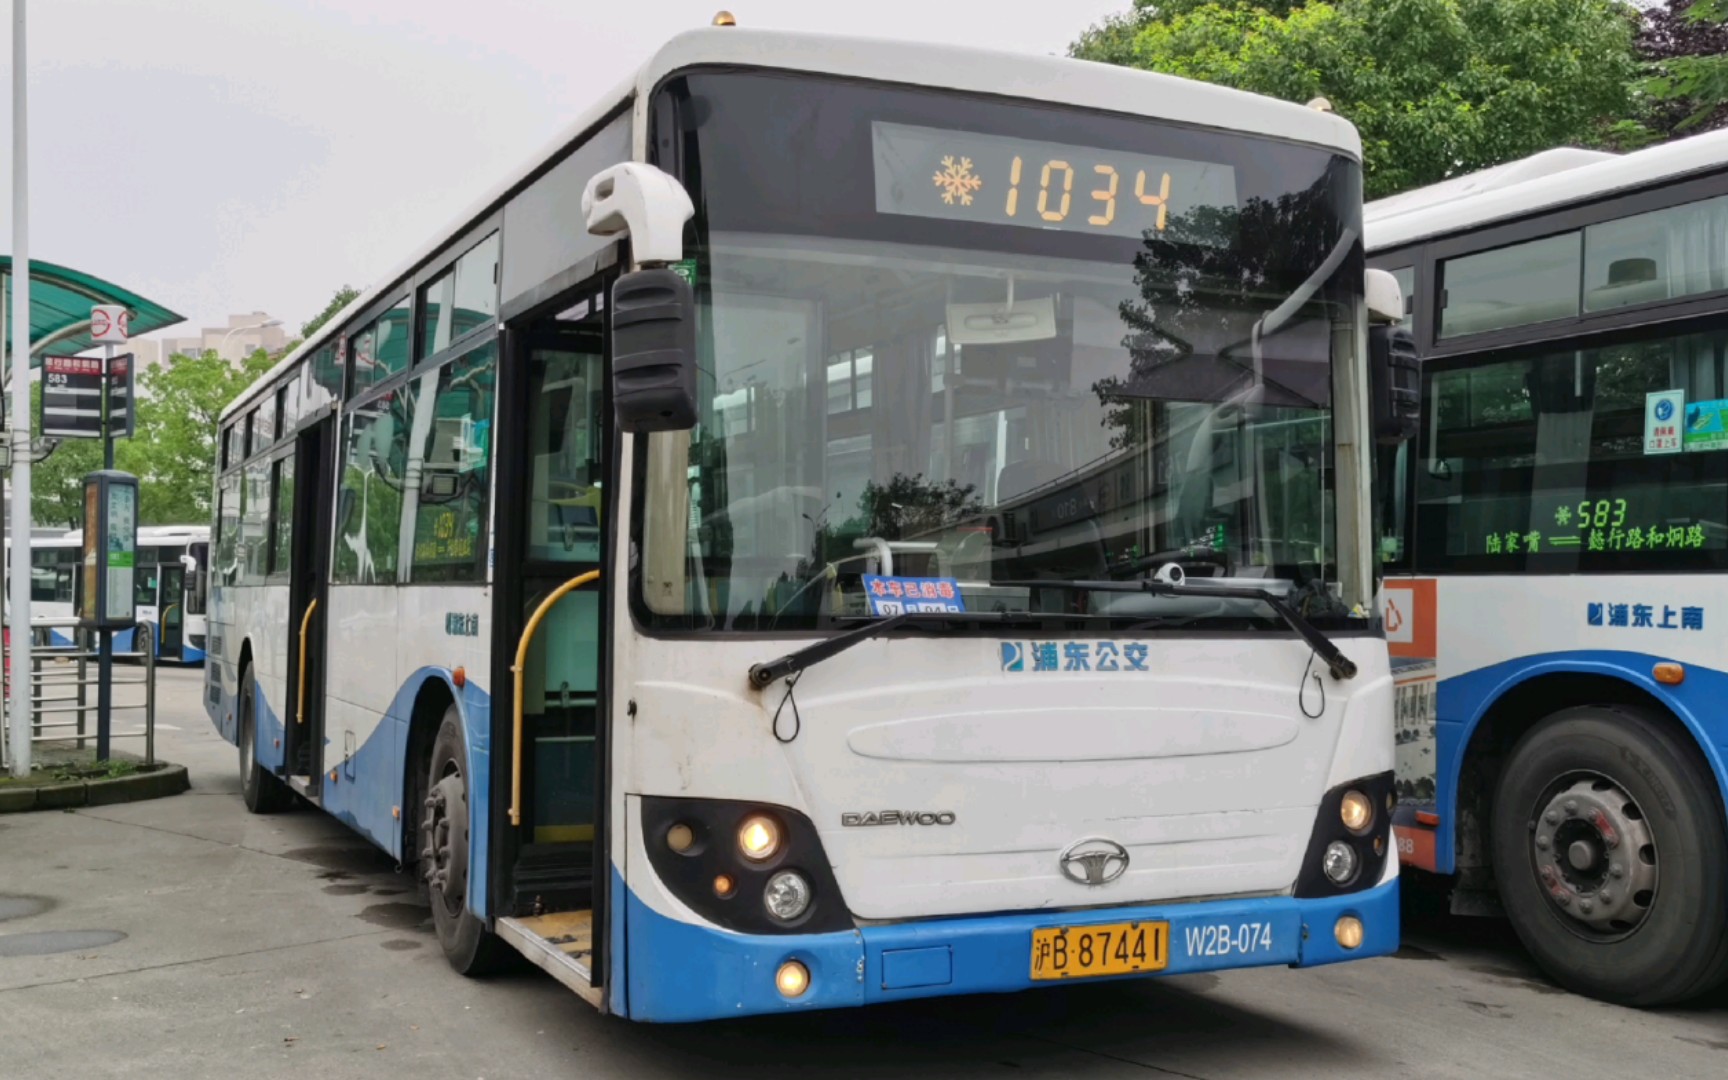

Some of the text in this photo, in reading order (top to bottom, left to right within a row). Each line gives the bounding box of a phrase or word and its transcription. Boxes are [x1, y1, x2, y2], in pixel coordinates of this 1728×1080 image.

[1005, 156, 1171, 231] 1034
[48, 373, 68, 384] 583
[1577, 498, 1627, 529] 583
[1485, 530, 1542, 554] 陆家嘴
[870, 579, 955, 599] 本车已消毒
[883, 604, 898, 615] 07
[1608, 602, 1704, 631] 浦东上南
[1031, 642, 1149, 671] 浦东公交
[841, 810, 956, 827] DAEWOO
[1185, 922, 1272, 957] W2B-074
